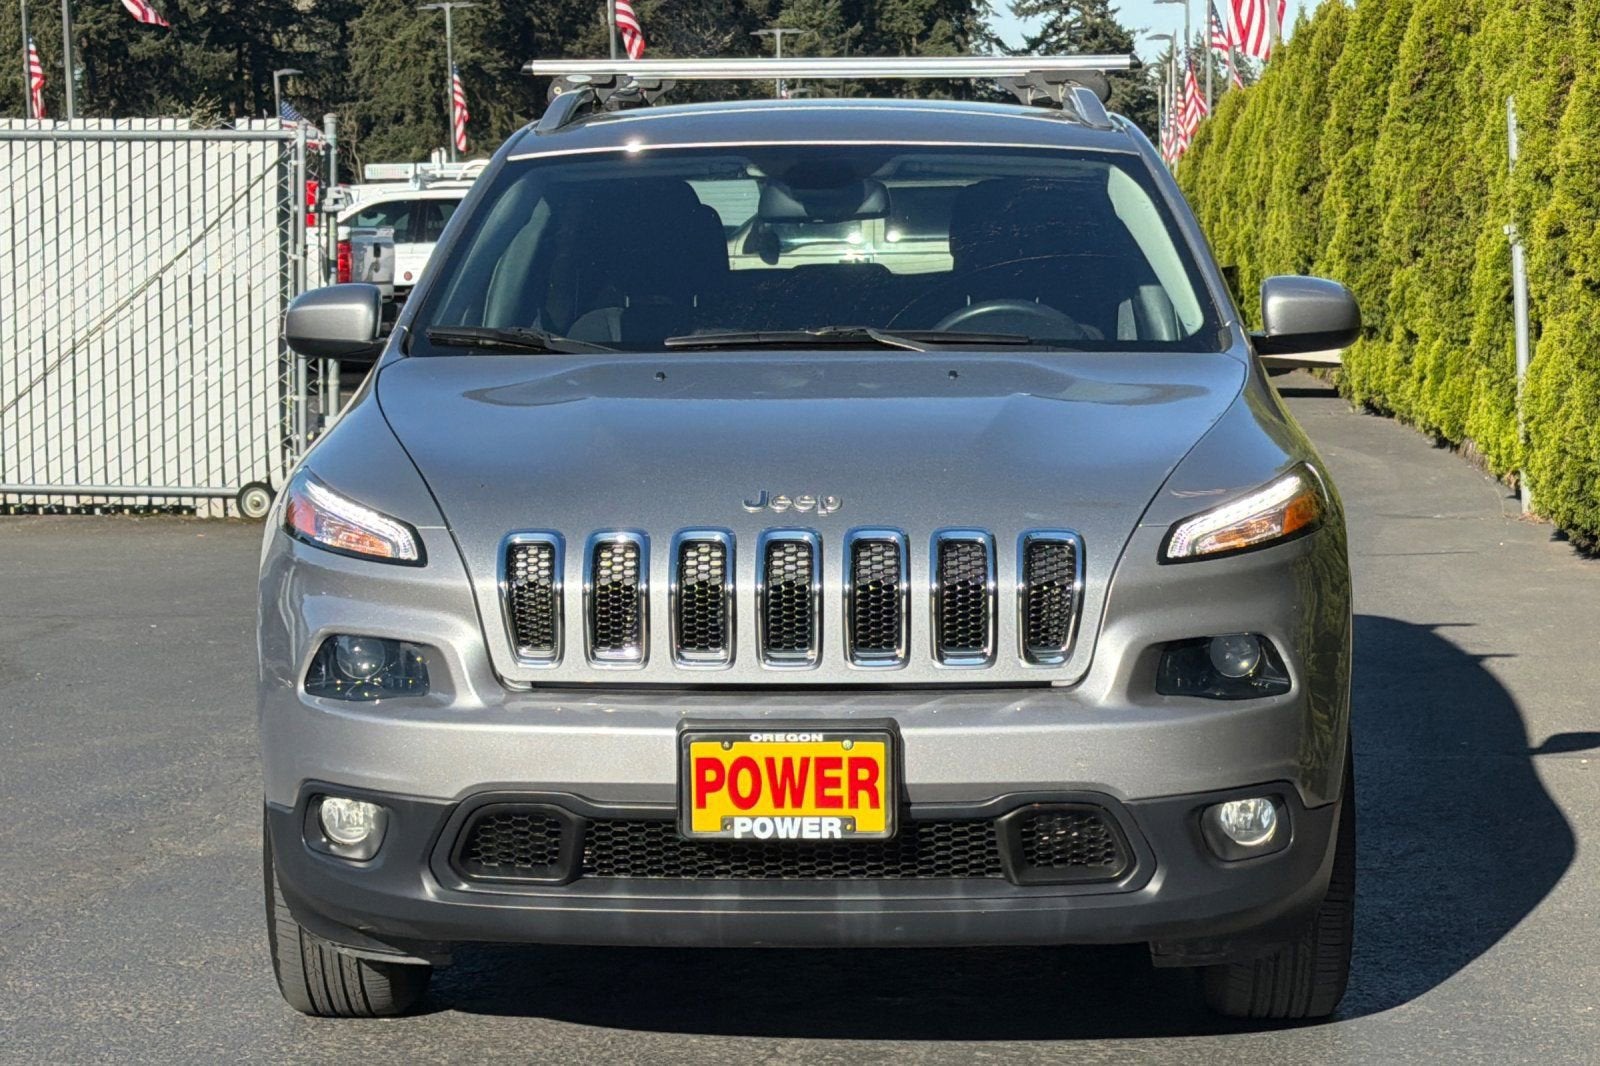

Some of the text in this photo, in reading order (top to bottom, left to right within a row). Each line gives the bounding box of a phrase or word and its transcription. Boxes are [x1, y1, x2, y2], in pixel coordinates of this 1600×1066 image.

[742, 489, 843, 516] Jeep
[750, 733, 823, 742] OREGON
[695, 755, 880, 810] POWER
[733, 817, 842, 839] POWER
